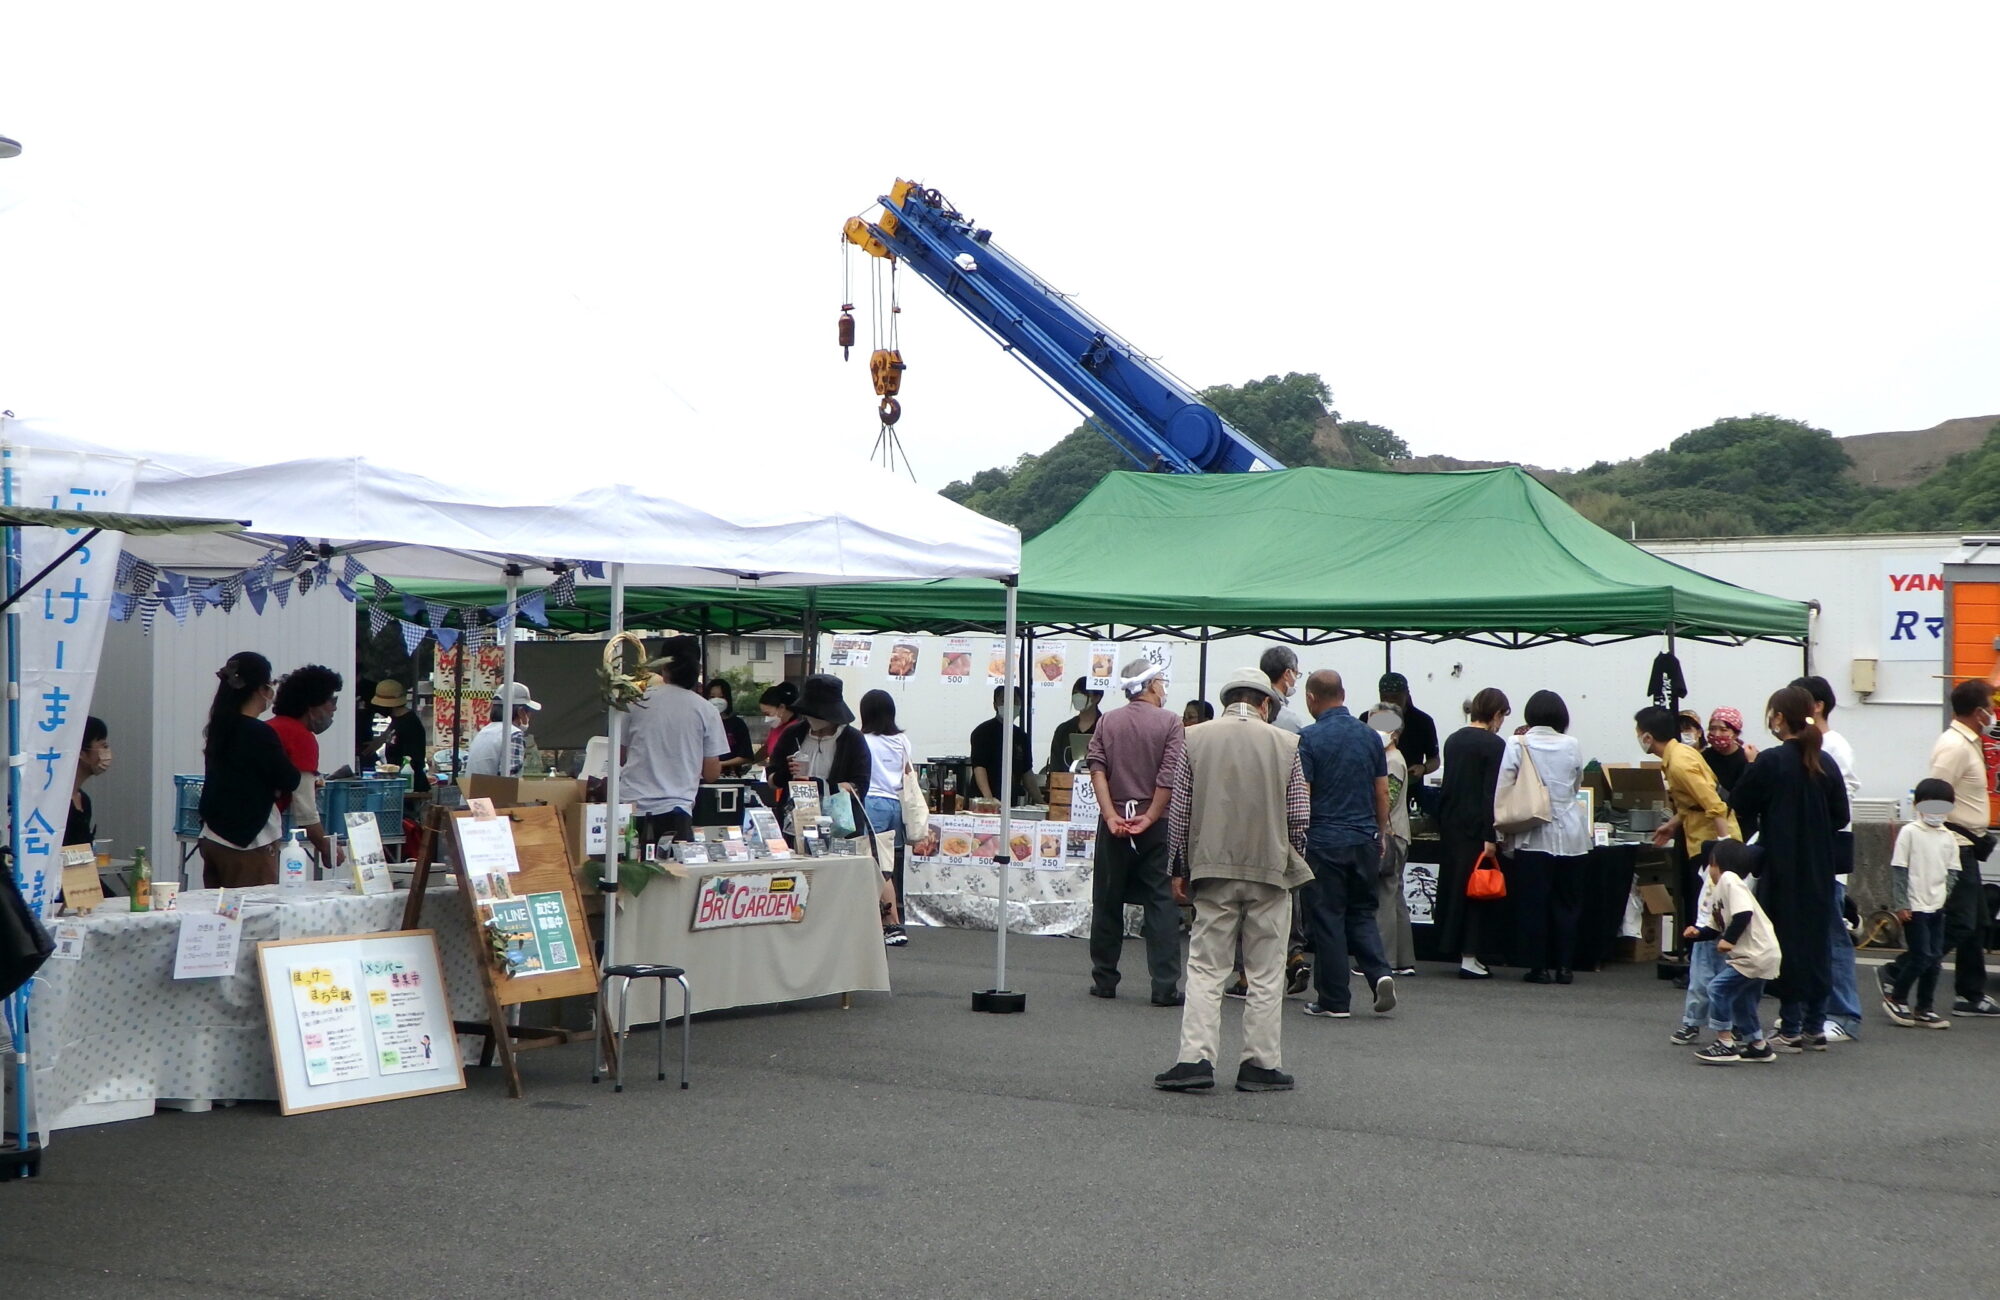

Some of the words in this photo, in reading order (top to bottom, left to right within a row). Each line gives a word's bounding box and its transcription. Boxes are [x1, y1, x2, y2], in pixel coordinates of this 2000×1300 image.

[947, 675, 963, 684] 500
[994, 677, 1006, 685] 50
[1093, 678, 1110, 686] 250
[949, 856, 963, 864] 500
[978, 857, 995, 865] 500
[1042, 859, 1058, 867] 250
[732, 885, 799, 919] GARDEN
[504, 908, 529, 923] LINE
[365, 962, 403, 975] メンバー
